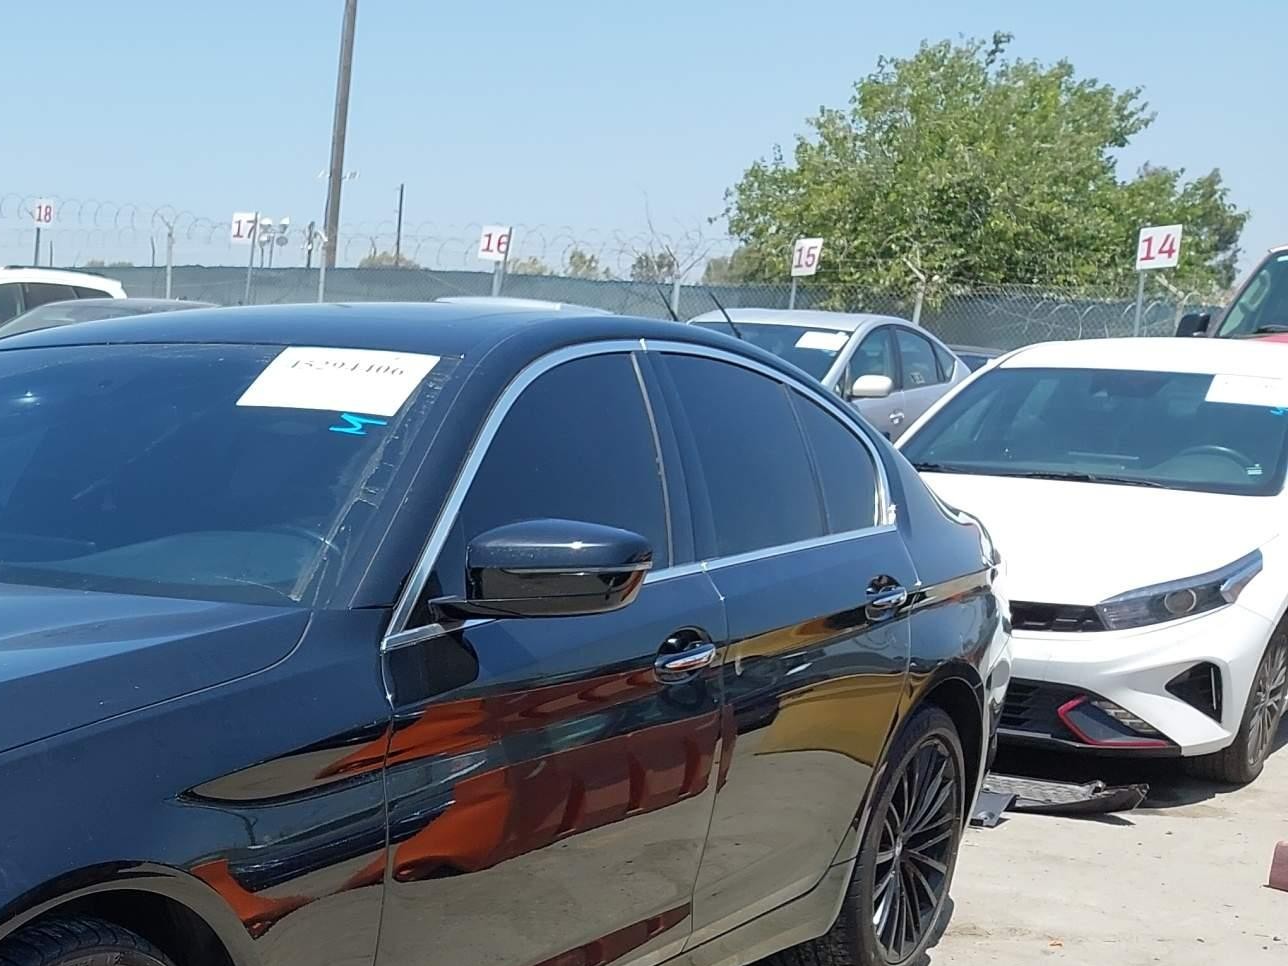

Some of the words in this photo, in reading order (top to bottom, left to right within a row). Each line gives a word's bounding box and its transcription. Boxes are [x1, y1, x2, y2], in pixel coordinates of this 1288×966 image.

[36, 204, 52, 223] 18
[232, 219, 257, 239] 17
[481, 232, 510, 254] 16
[1140, 233, 1176, 261] 14
[794, 246, 818, 268] 15
